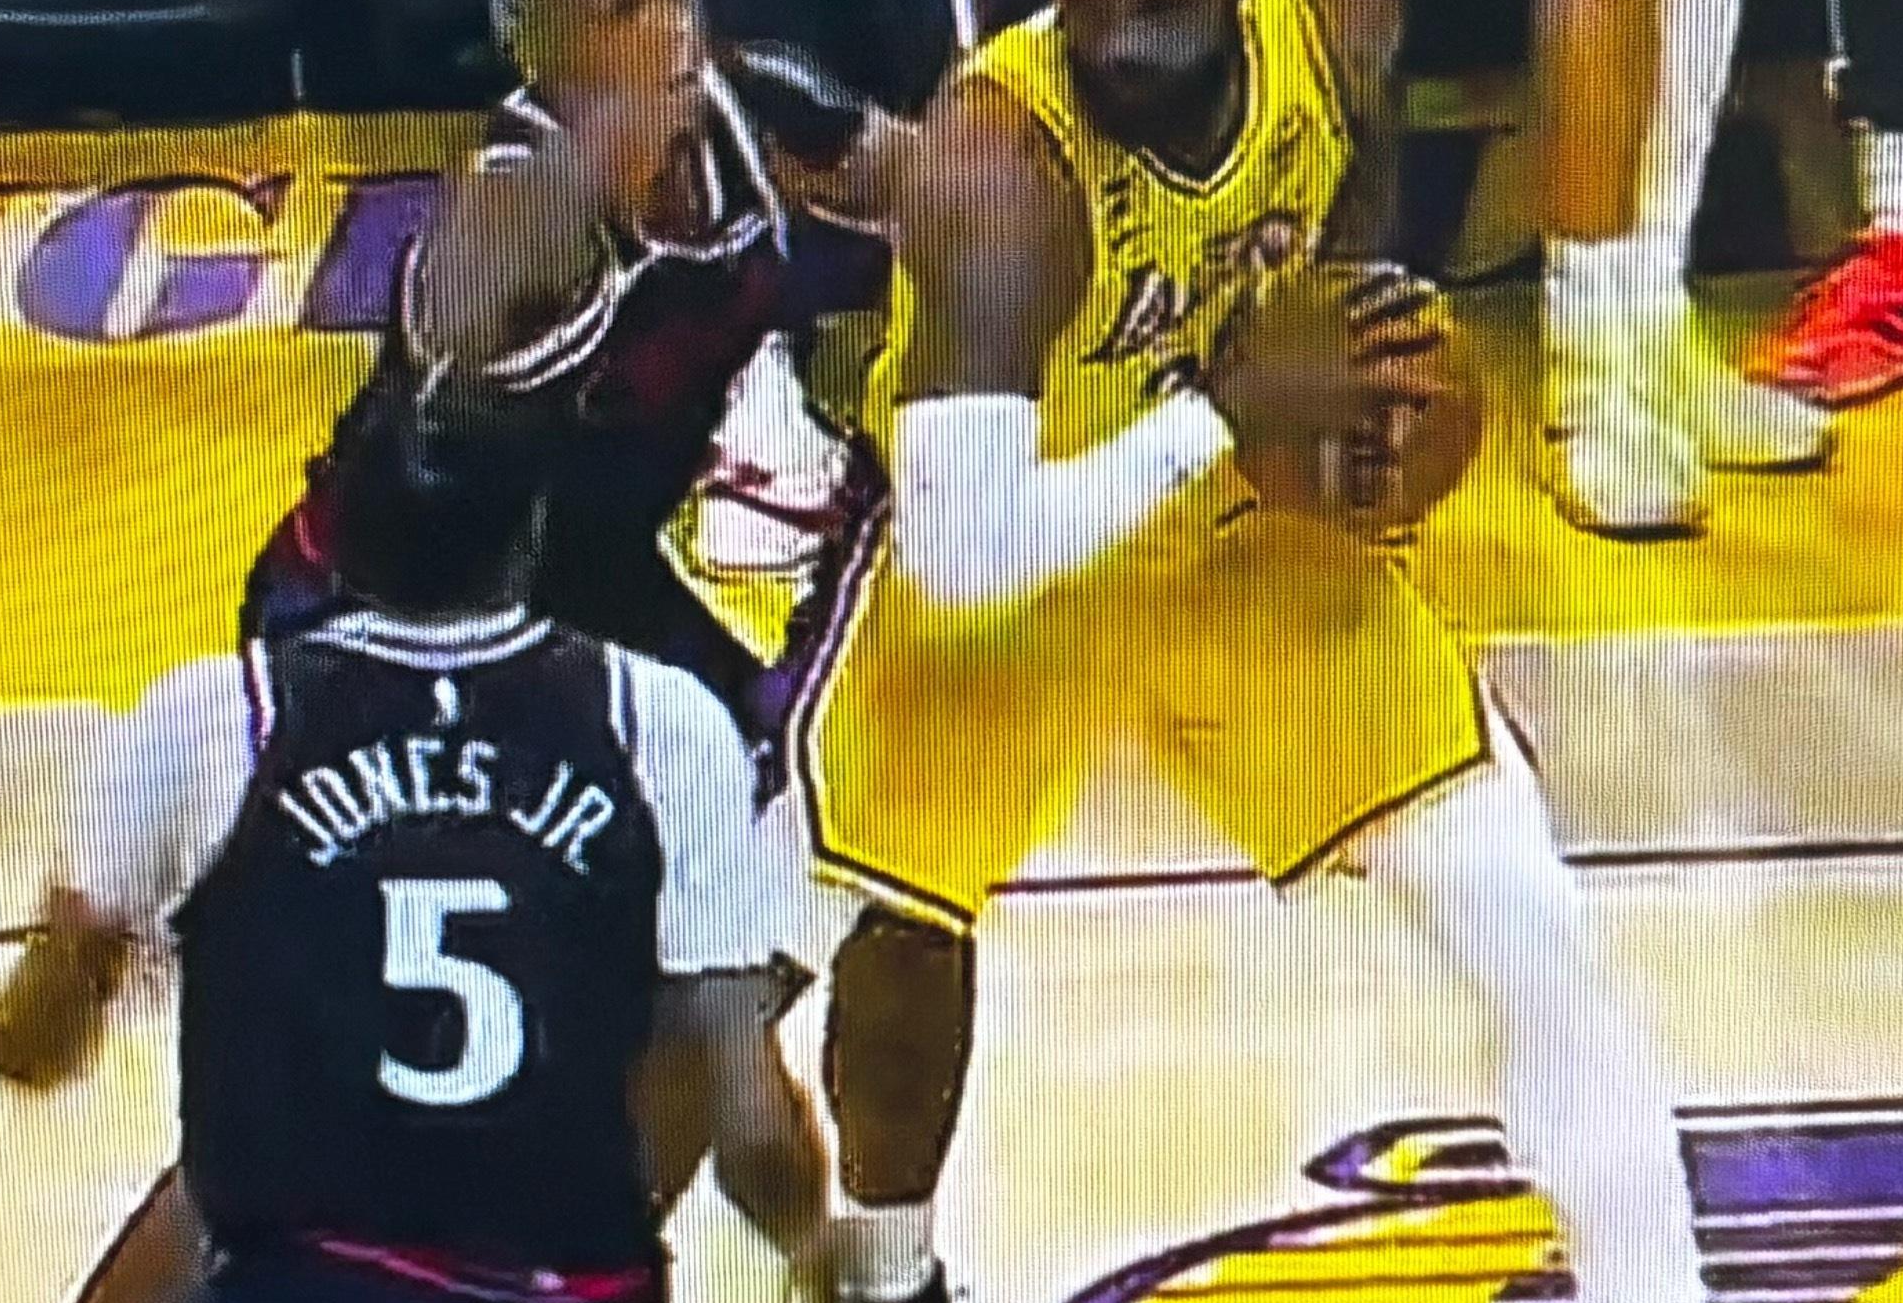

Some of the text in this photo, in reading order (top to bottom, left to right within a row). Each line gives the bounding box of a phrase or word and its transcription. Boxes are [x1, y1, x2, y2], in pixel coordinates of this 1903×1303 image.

[277, 738, 616, 875] JONES JR
[377, 878, 525, 1106] 5
